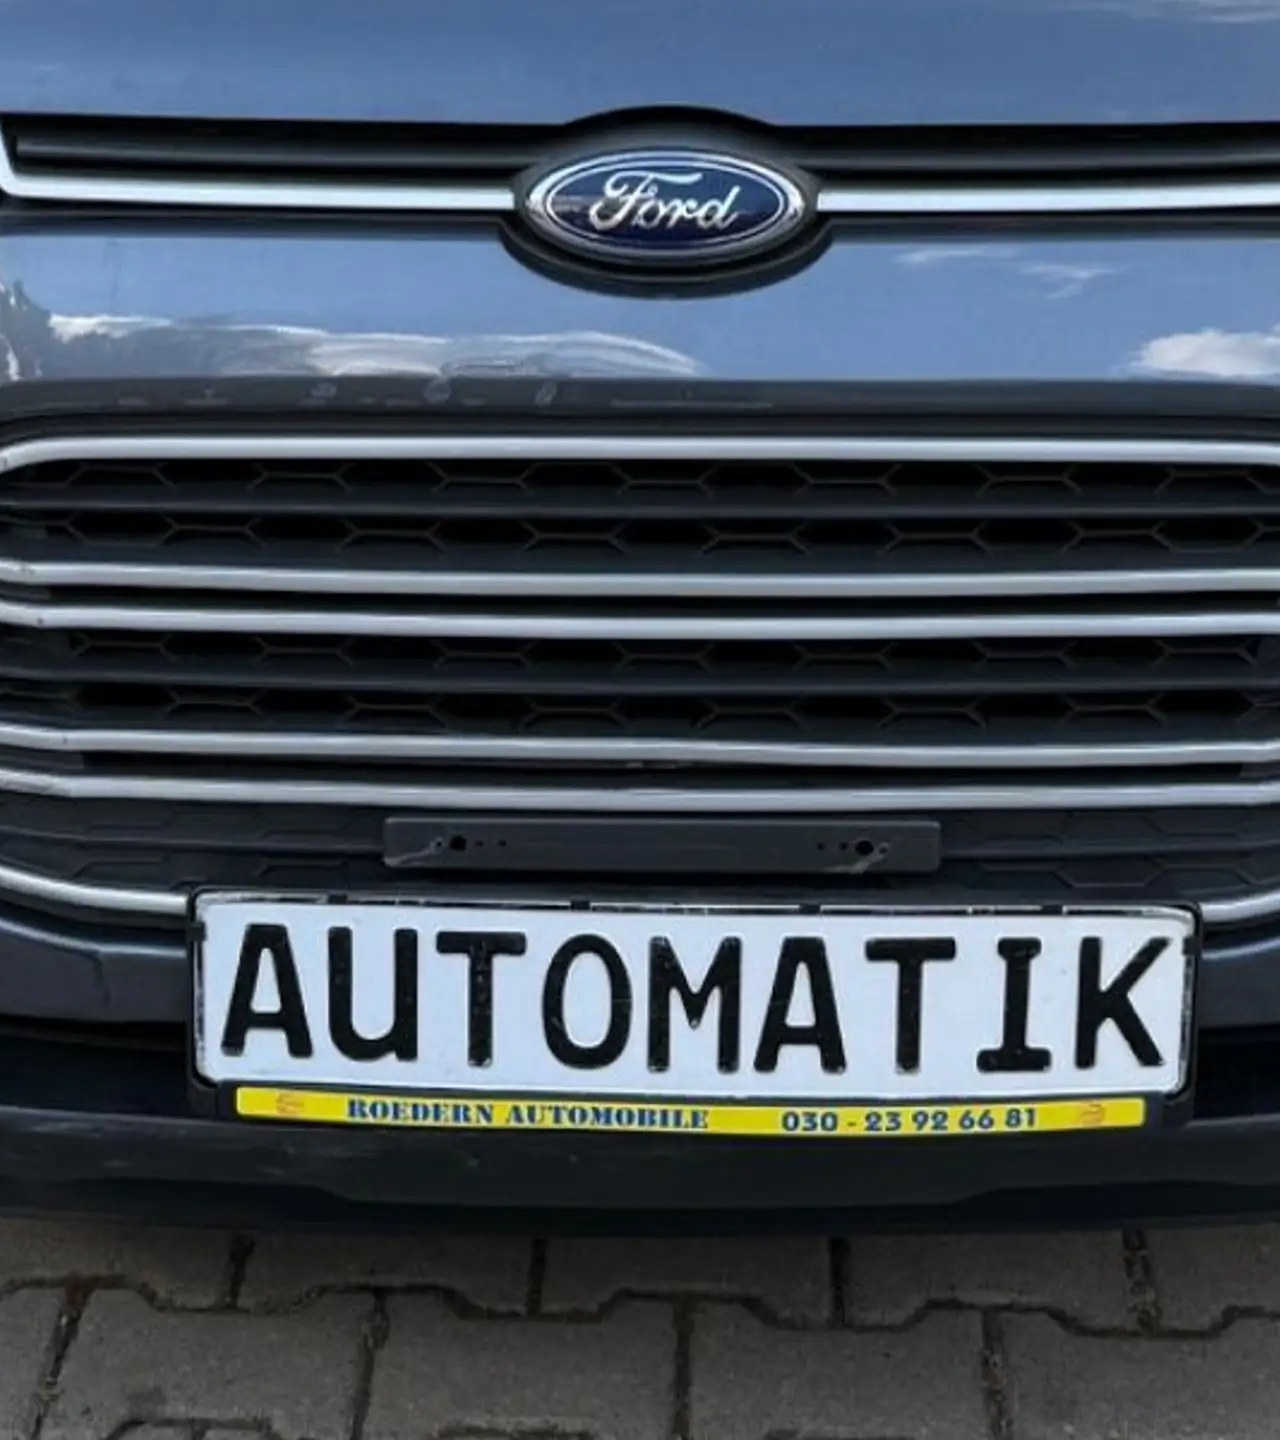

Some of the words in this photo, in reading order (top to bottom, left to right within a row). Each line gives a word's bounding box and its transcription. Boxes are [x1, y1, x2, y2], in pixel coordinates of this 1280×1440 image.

[588, 170, 740, 231] Ford
[220, 922, 1174, 1072] AUTOMATIK
[347, 1096, 494, 1124] ROEDERN
[505, 1103, 709, 1130] AUTOMOBILE
[782, 1110, 838, 1131] 030
[864, 1110, 901, 1131] 23
[912, 1110, 948, 1131] 92
[958, 1109, 994, 1130] 66
[1005, 1106, 1036, 1128] 81
